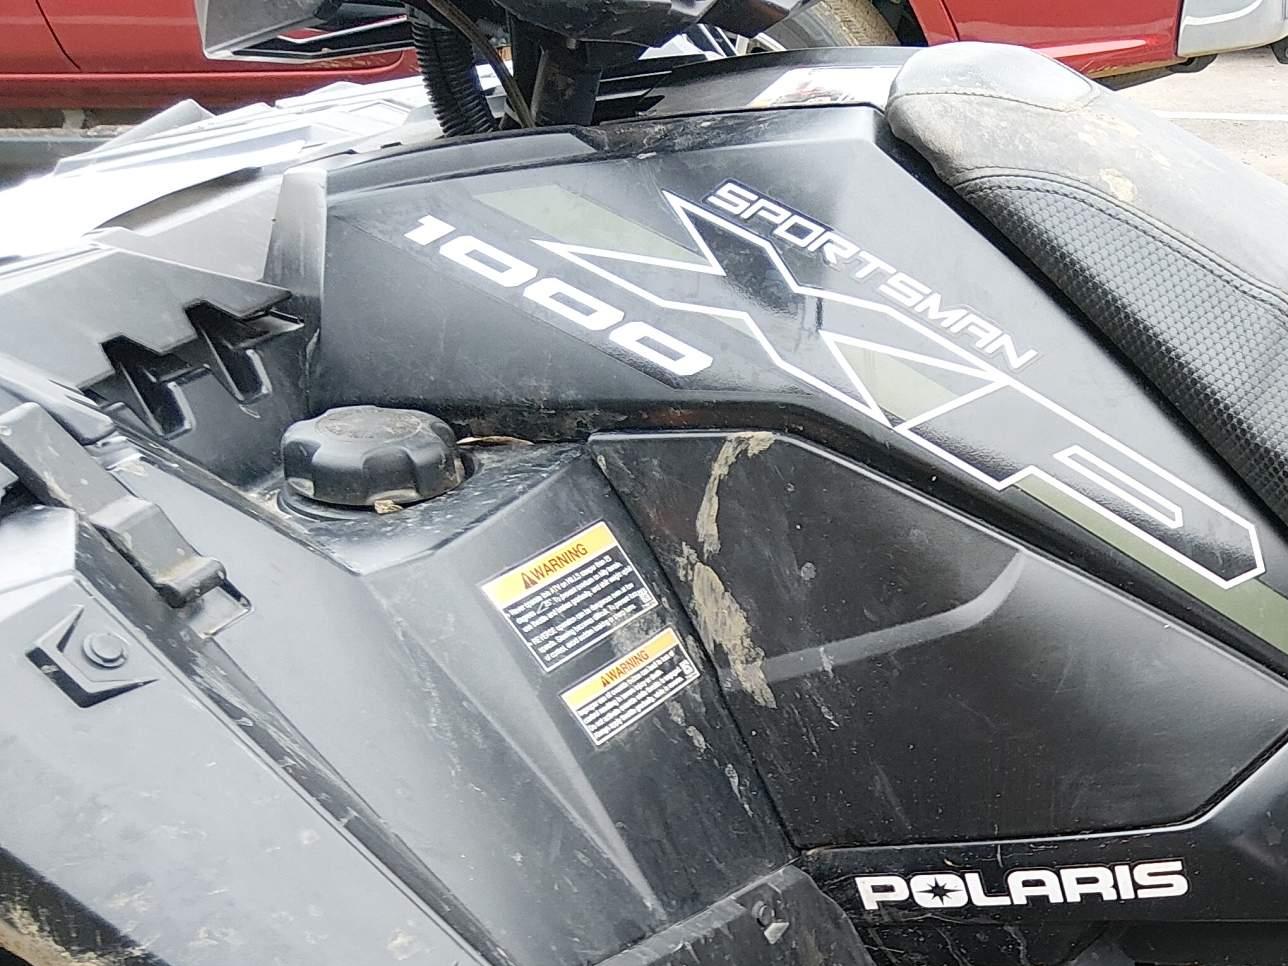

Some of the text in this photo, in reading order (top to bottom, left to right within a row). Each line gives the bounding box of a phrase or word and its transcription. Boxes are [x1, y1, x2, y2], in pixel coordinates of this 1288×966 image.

[404, 214, 713, 376] 1000
[706, 180, 1039, 370] SPORTSMAN
[531, 543, 588, 581] WARNING
[606, 649, 650, 681] WARNING
[855, 860, 1189, 910] POLARIS
